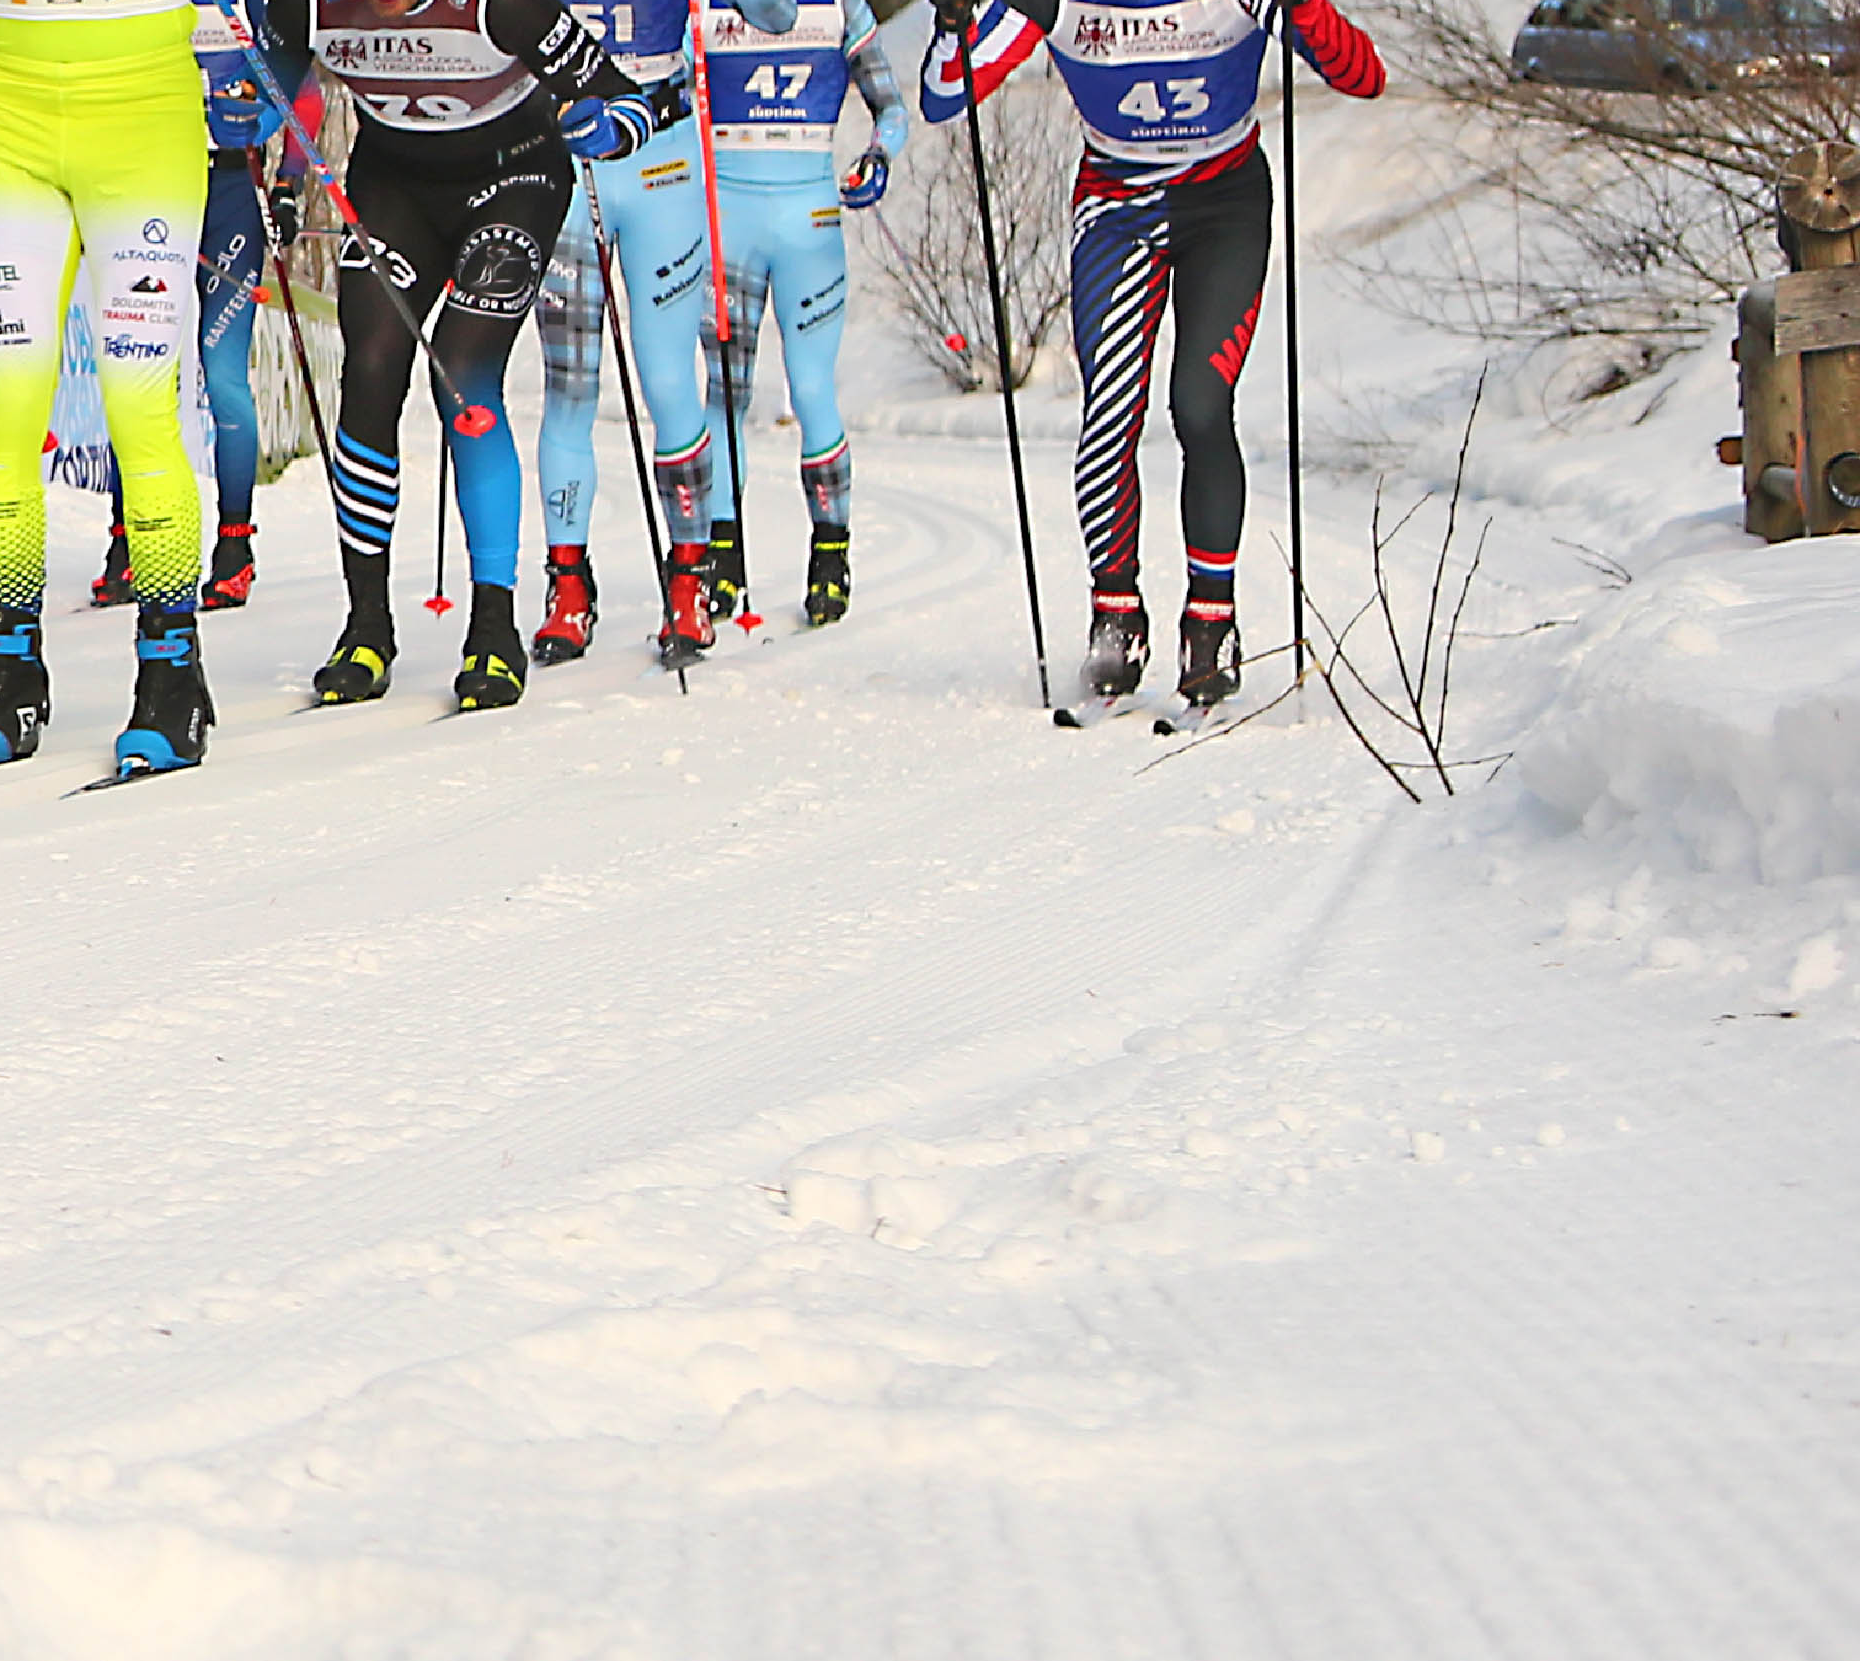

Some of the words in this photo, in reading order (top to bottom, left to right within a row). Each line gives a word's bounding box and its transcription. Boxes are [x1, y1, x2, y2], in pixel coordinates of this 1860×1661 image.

[570, 3, 633, 42] 51
[1122, 14, 1179, 36] ITAS
[373, 37, 433, 54] ITAS
[743, 64, 814, 100] 47
[1117, 77, 1211, 123] 43
